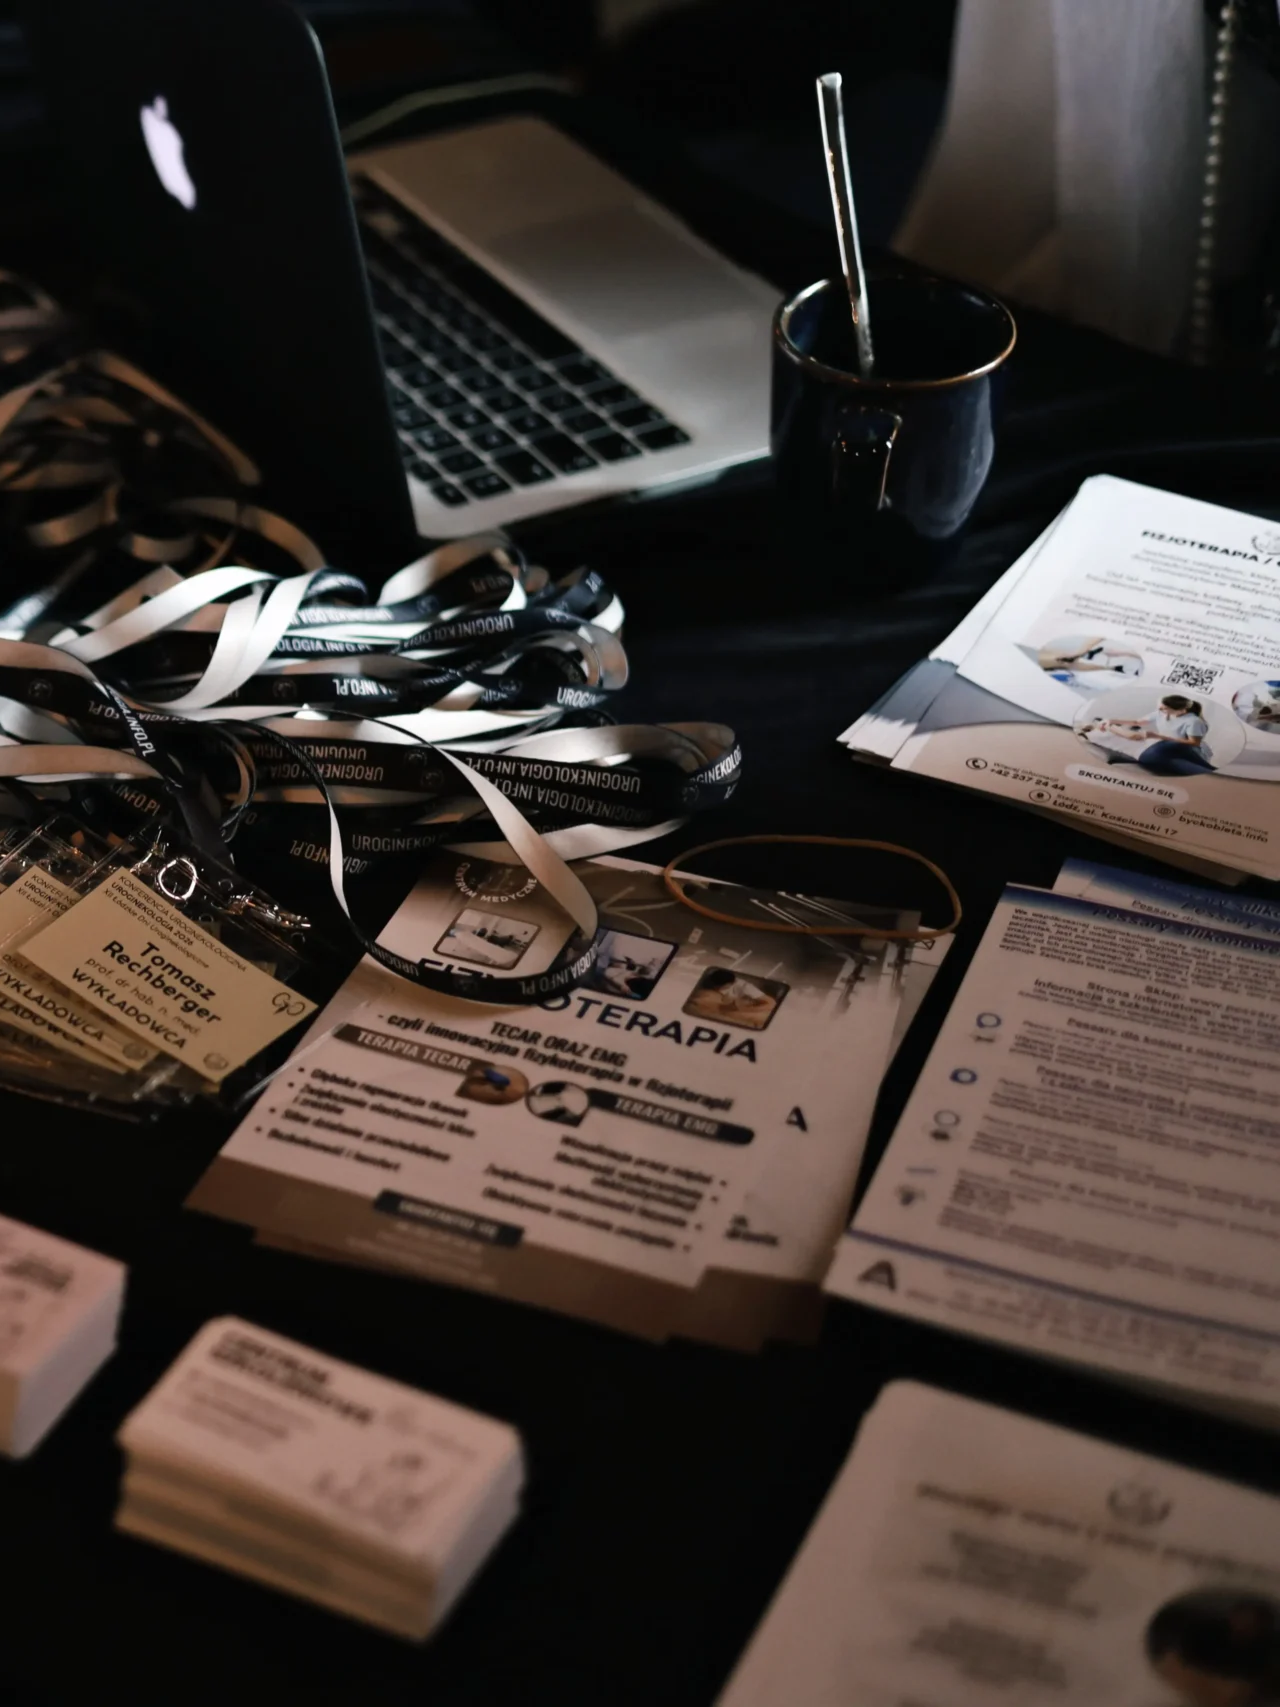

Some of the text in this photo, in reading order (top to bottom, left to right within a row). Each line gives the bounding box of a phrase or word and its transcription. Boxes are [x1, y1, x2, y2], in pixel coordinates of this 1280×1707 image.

[1141, 529, 1259, 563] FIZJOTERAPIA
[1012, 772, 1034, 784] 237
[1035, 777, 1050, 788] 24
[1051, 782, 1067, 792] 44
[1077, 768, 1177, 801] SKONTAKTUJ SIĘ
[1101, 811, 1161, 833] Kościuszki
[1163, 827, 1179, 837] 17
[454, 862, 539, 903] CENTRUM MEDYCZNE
[111, 881, 194, 946] UROGINEKOLOGIA 2026
[118, 875, 248, 973] KONFERENCJA UROGINEKOLOGICZNA
[137, 914, 151, 928] Dni
[102, 939, 223, 1025] Rechberger
[140, 941, 217, 1002] Tomasz
[1086, 981, 1131, 1000] Strona
[71, 966, 188, 1050] WYKŁADOWCA
[84, 957, 203, 1037] prof. dr hab. n. med.
[356, 1029, 472, 1072] TERAPIA TECAR
[387, 1013, 422, 1033] czyli
[425, 1021, 520, 1058] innowacyjna
[522, 1047, 624, 1084] fizykoterapia
[490, 1020, 629, 1068] TECAR ORAZ EMG
[613, 1095, 720, 1136] TERAPIA EMG
